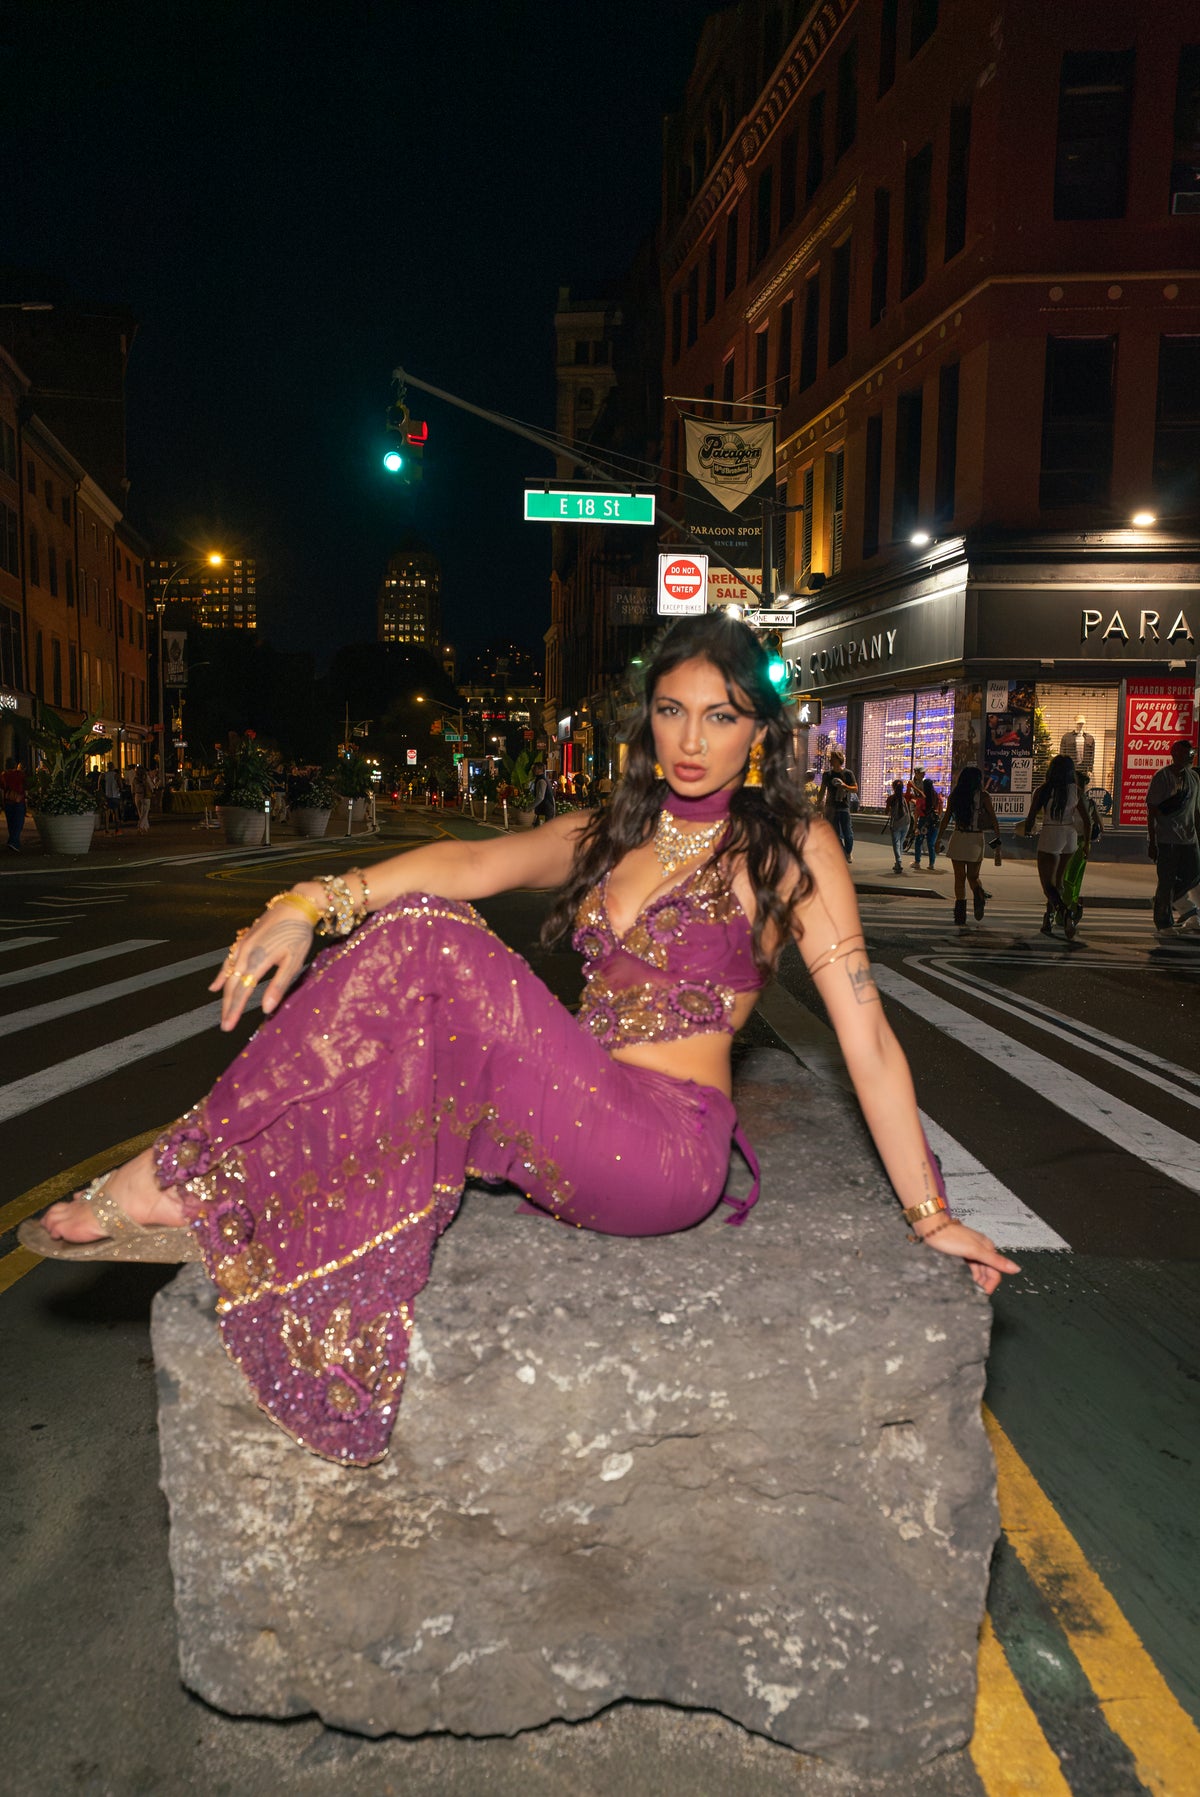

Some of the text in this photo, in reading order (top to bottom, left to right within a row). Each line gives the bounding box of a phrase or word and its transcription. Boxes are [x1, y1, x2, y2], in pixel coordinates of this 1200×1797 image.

[701, 434, 760, 464] Paragon
[560, 498, 620, 516] E 18 St
[690, 526, 735, 536] PARAGON
[671, 585, 694, 593] ENTER
[716, 588, 748, 599] SALE
[685, 604, 702, 612] BIKES
[753, 614, 767, 622] ONE
[1082, 609, 1195, 640] PARA
[785, 628, 897, 679] DS COMPANY
[1129, 685, 1165, 695] PARAGON
[991, 698, 1005, 709] Us
[1135, 702, 1190, 711] WAREHOUSE
[1132, 711, 1190, 732] SALE
[1128, 739, 1170, 751] 40-70%
[1133, 758, 1153, 767] GOING
[1155, 758, 1164, 767] ON
[993, 802, 1025, 813] UN CLUB
